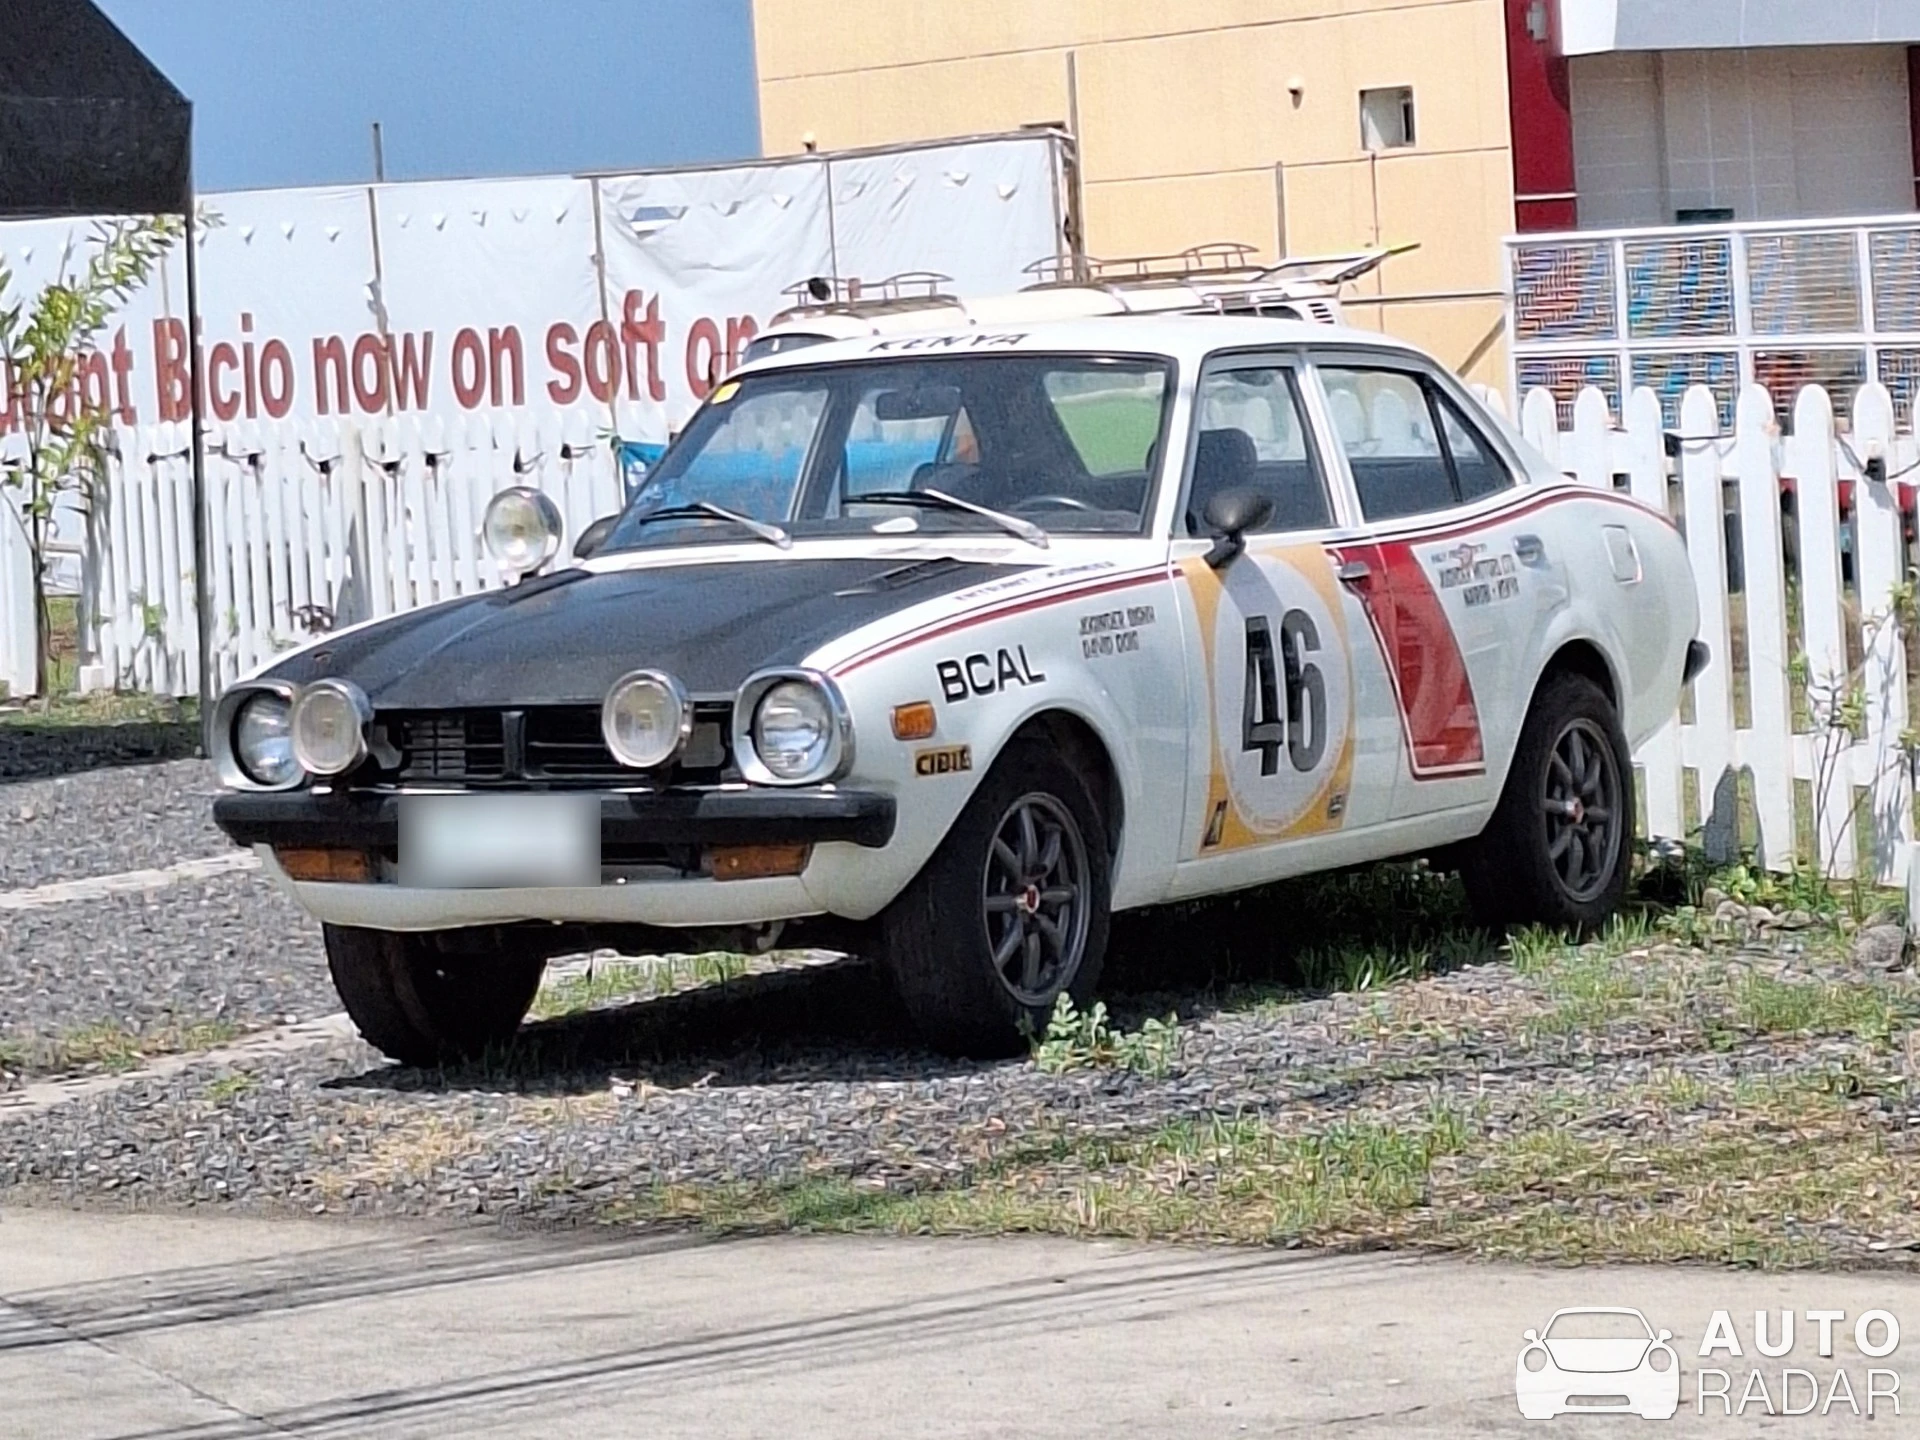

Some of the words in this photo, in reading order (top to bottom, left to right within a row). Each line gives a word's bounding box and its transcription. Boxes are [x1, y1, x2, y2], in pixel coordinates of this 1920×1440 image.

[152, 311, 296, 424] Bicio
[312, 330, 434, 416] now
[451, 325, 525, 410] on
[545, 290, 666, 405] soft
[935, 644, 1047, 704] BCAL
[1242, 608, 1328, 777] 46
